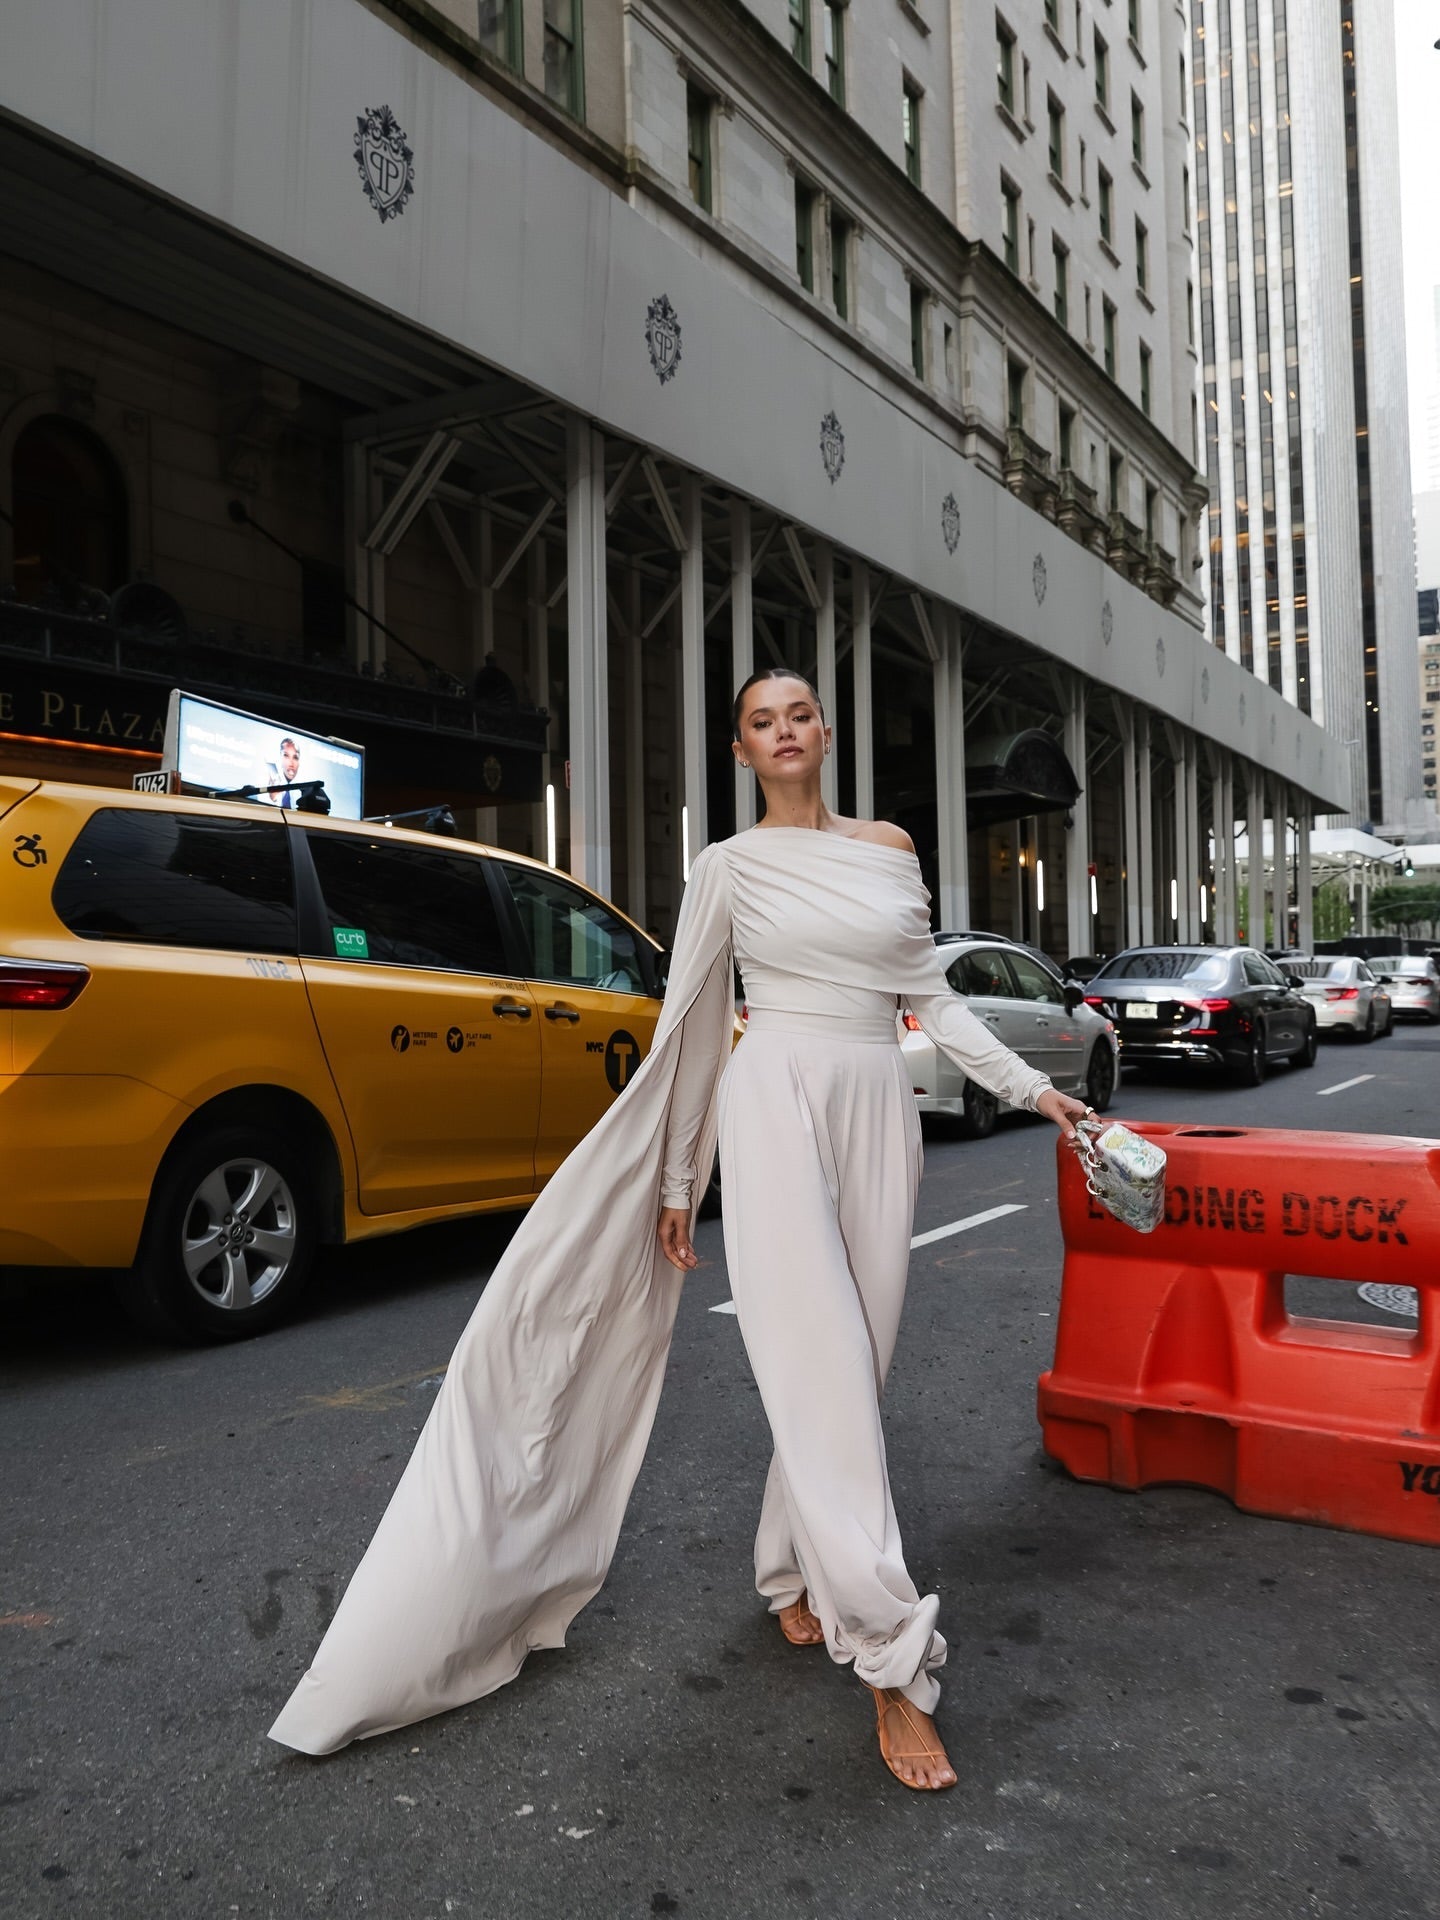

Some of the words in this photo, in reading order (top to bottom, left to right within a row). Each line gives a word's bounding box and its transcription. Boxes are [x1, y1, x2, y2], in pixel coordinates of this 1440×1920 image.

[40, 690, 164, 742] PLAZA
[137, 774, 165, 793] 1V62
[336, 932, 364, 946] curb
[586, 1042, 604, 1053] NYC
[1282, 1191, 1409, 1246] DOCK
